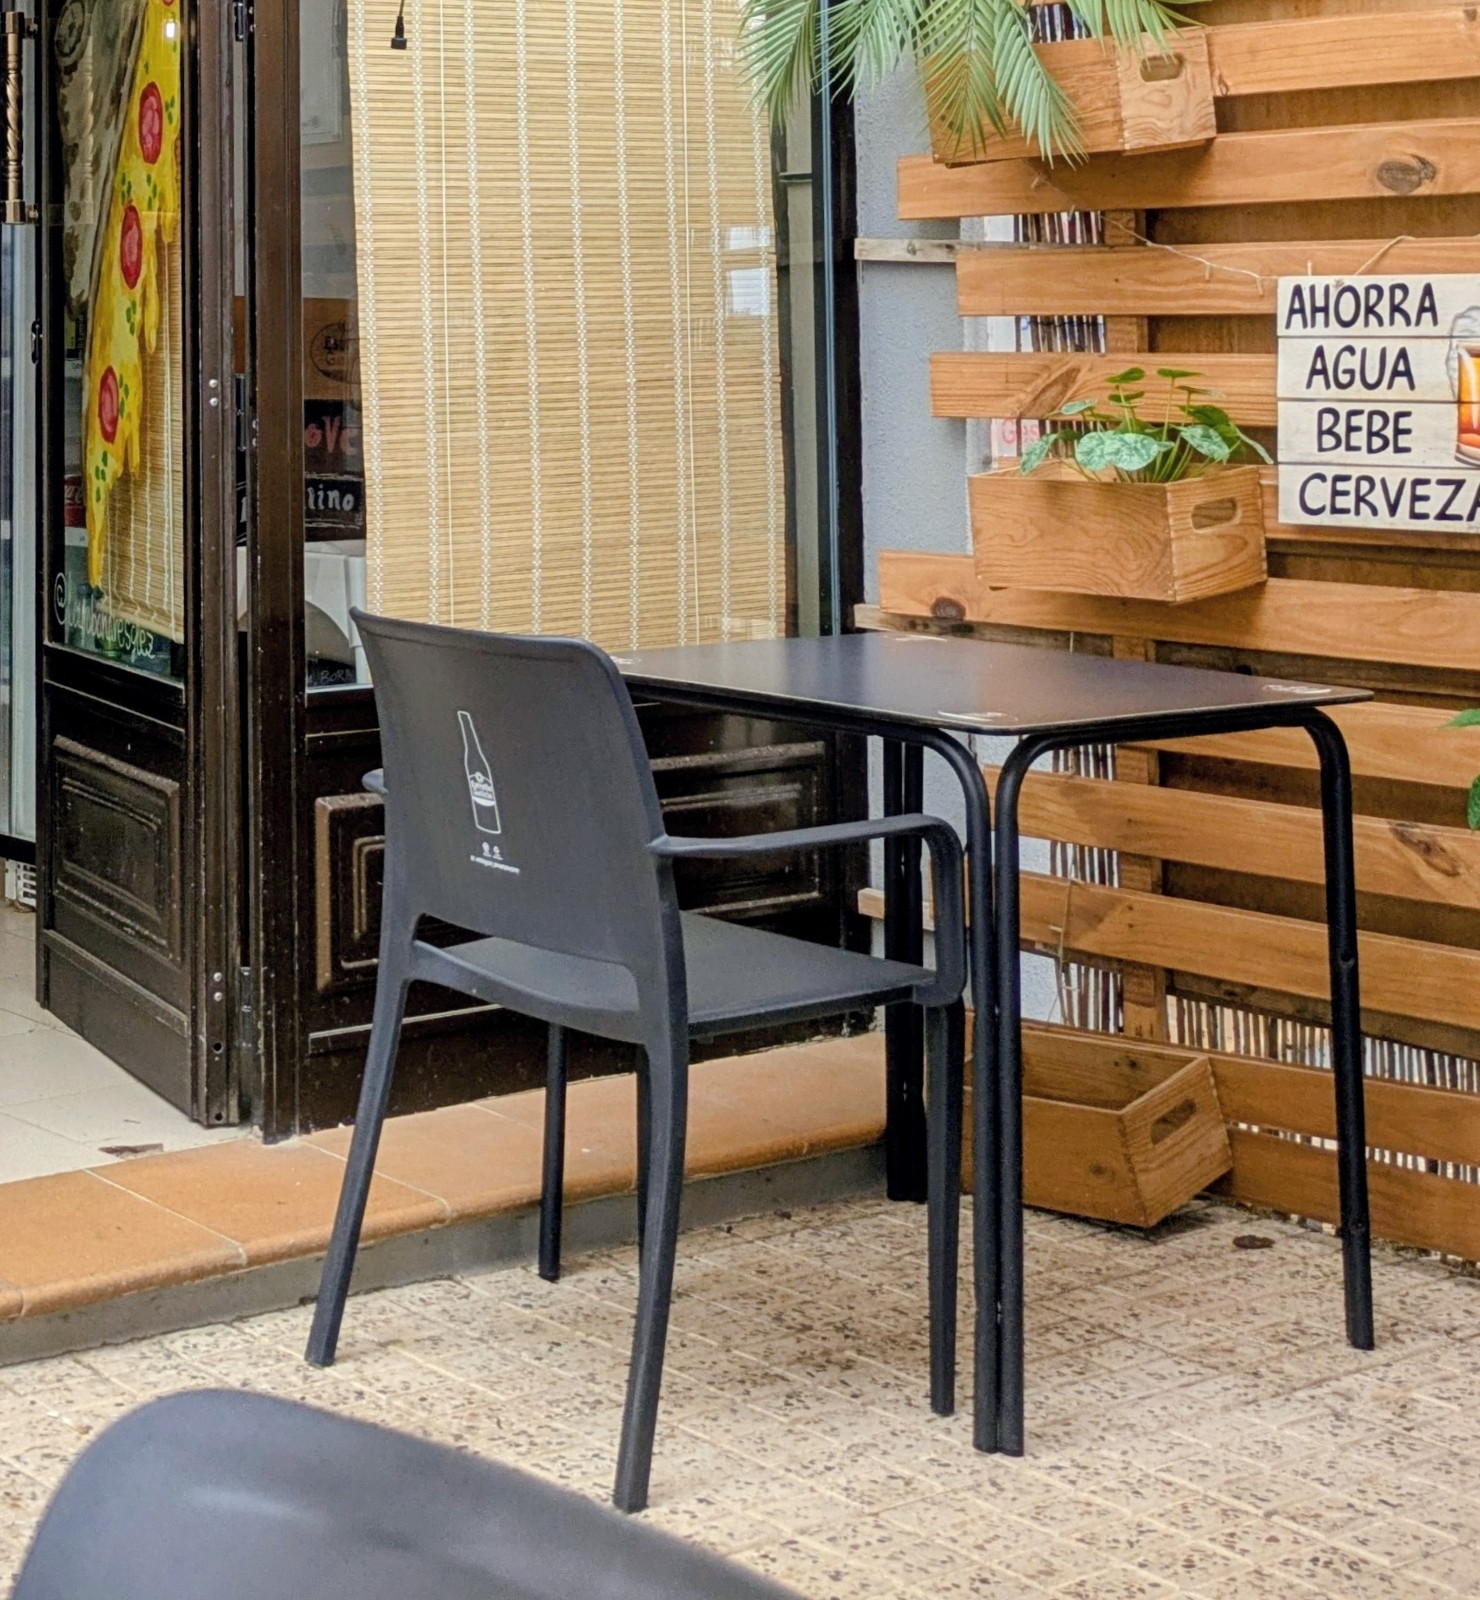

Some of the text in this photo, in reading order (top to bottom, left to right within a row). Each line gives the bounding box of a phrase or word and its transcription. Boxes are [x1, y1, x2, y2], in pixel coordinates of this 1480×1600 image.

[1285, 282, 1439, 329] AHORRA
[1306, 345, 1415, 391] AGUA
[1317, 407, 1413, 454] BEBE
